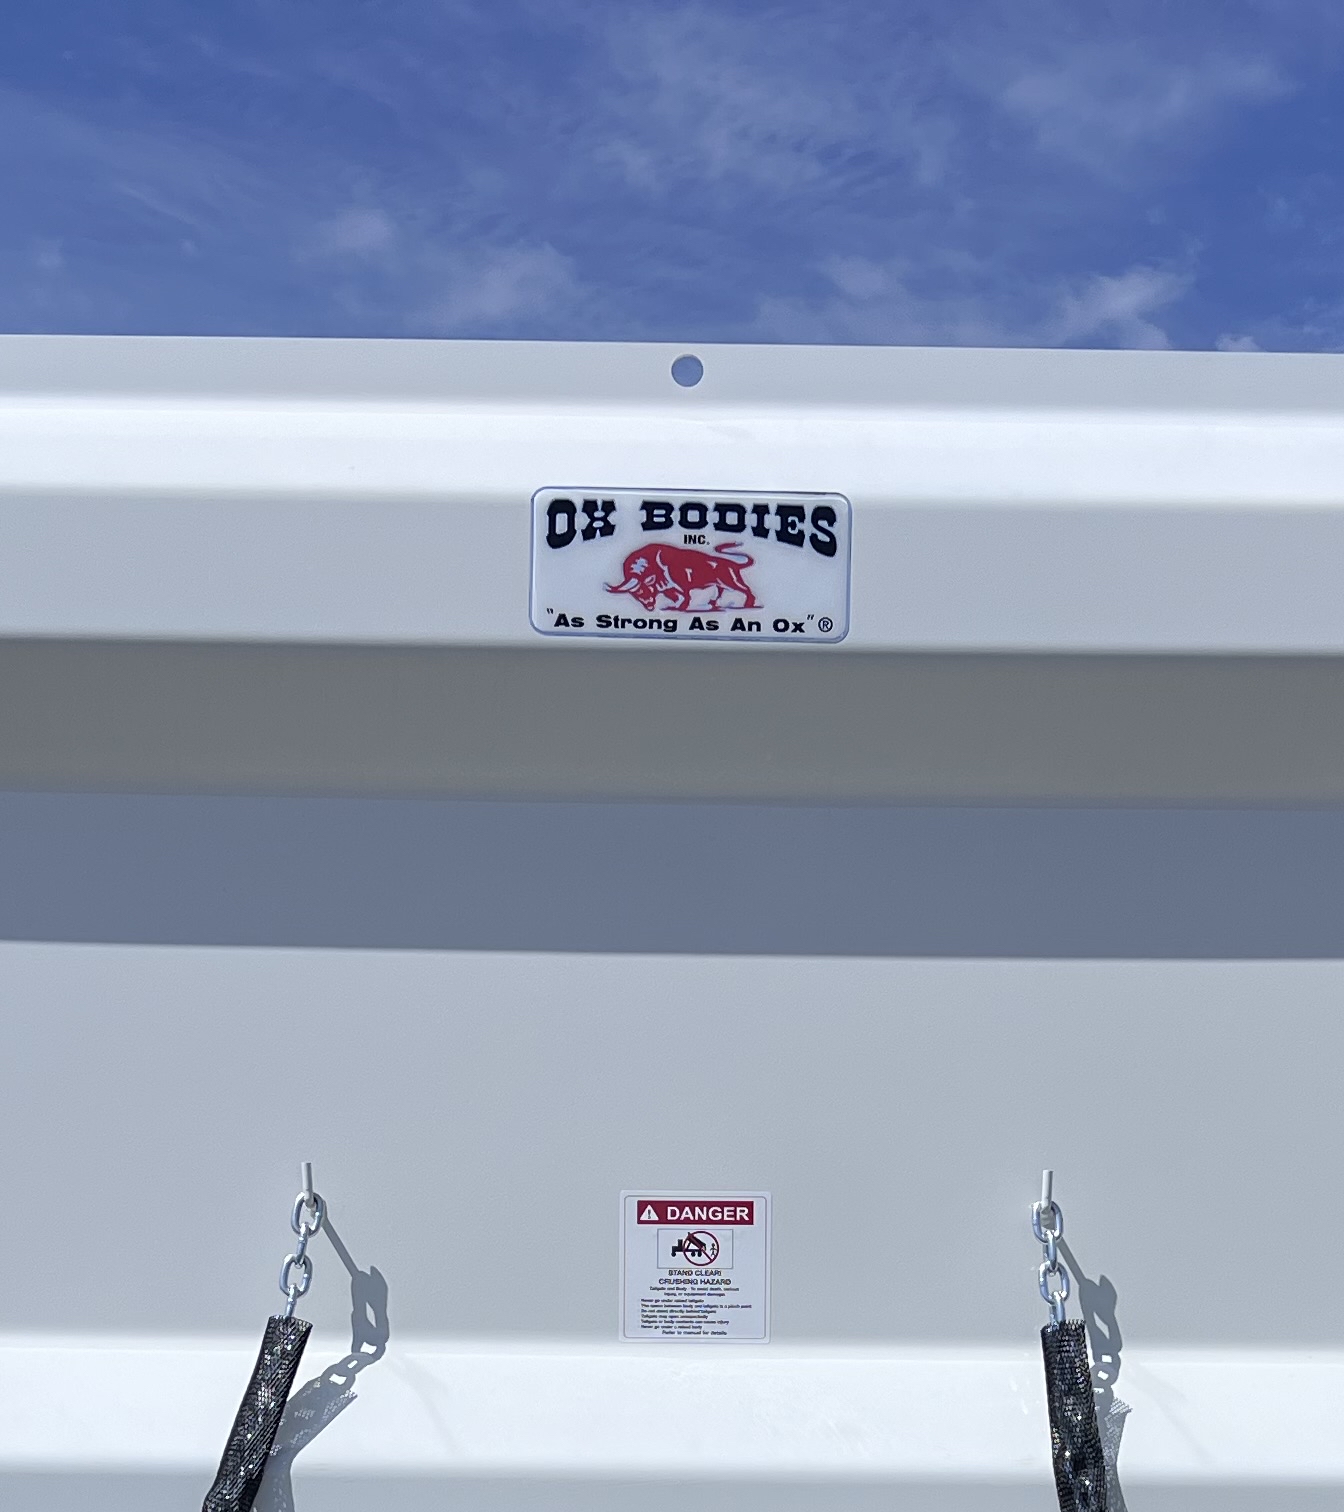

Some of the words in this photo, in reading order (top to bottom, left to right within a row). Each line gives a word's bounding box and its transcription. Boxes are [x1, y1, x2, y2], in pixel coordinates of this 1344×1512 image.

[546, 498, 617, 549] OX
[640, 499, 838, 557] BODIES
[683, 534, 710, 546] INC.
[595, 613, 678, 633] Strong
[689, 616, 720, 631] As
[730, 617, 761, 633] An
[666, 1206, 750, 1221] DANGER
[668, 1269, 693, 1277] STAND
[699, 1278, 732, 1286] HAZARD
